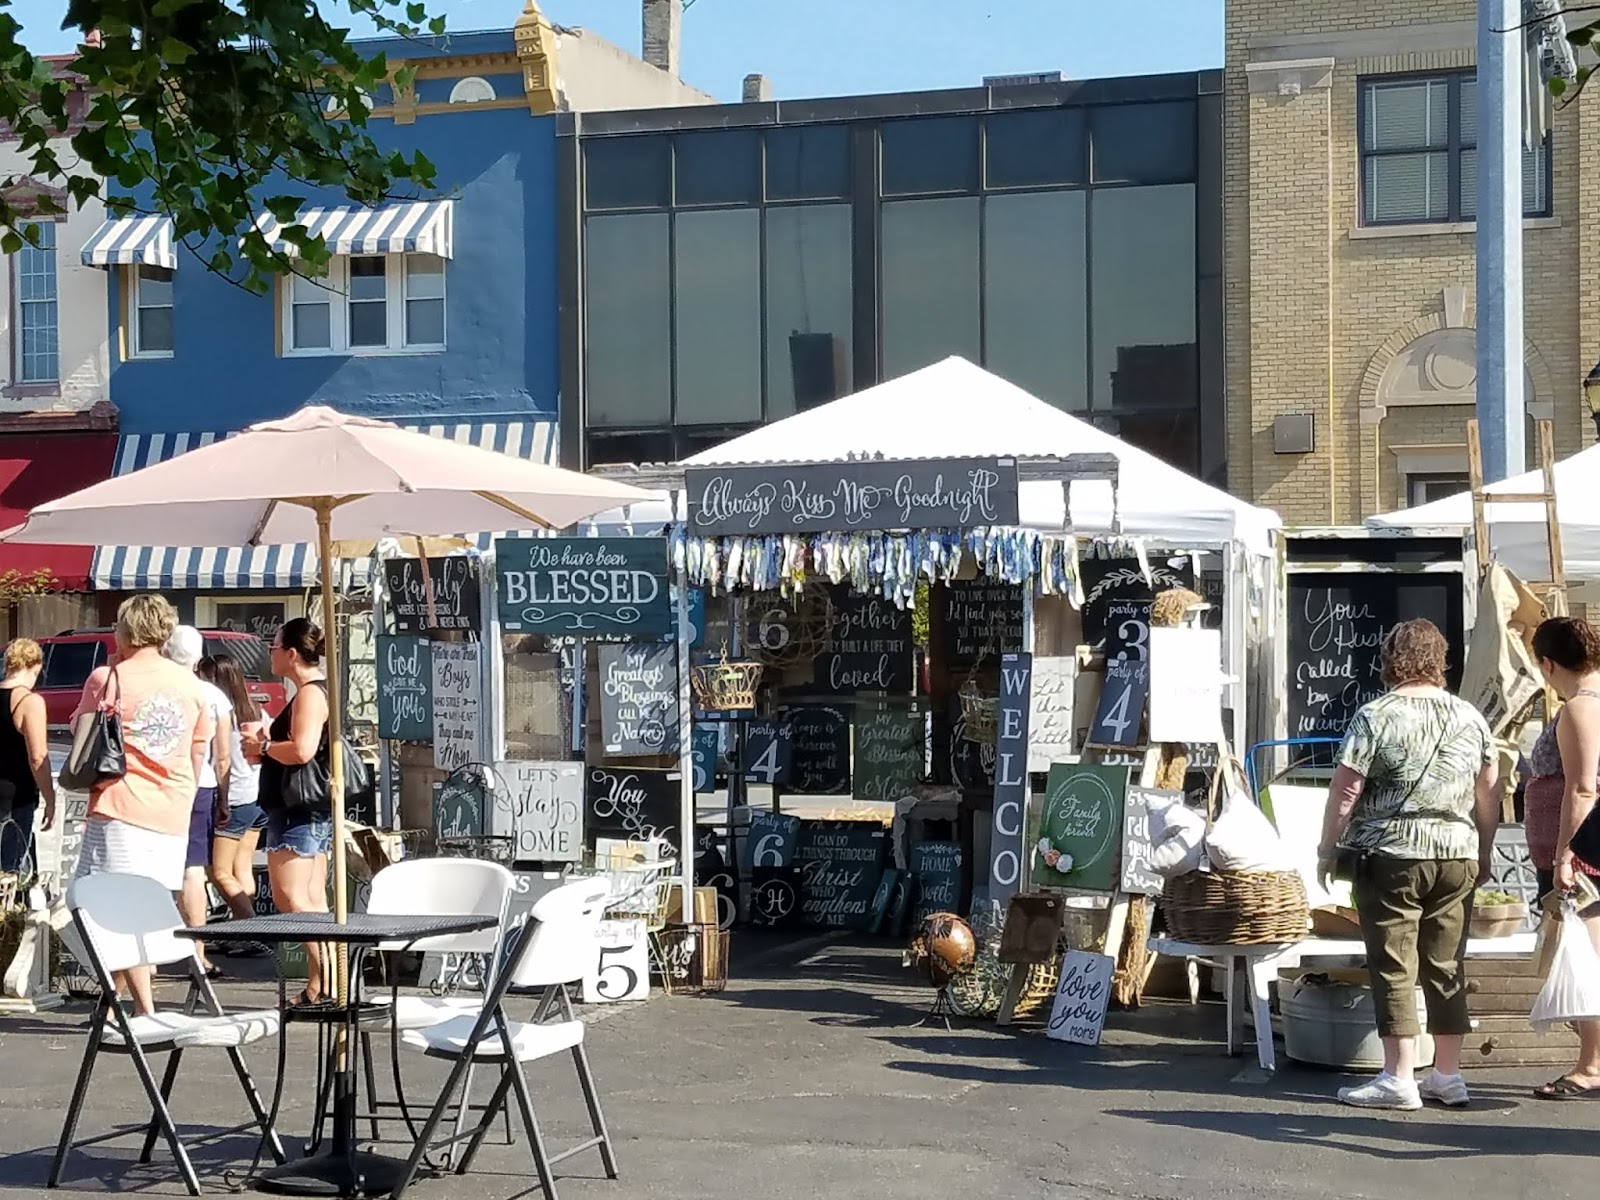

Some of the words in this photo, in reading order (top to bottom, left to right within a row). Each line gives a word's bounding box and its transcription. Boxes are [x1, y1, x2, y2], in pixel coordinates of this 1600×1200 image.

[696, 477, 776, 527] Always
[781, 479, 835, 524] Kiss
[834, 479, 892, 524] Me
[894, 468, 999, 523] Goodnight
[530, 545, 559, 568] We
[561, 545, 594, 567] have
[595, 545, 627, 566] been
[504, 570, 659, 604] BLESSED
[954, 590, 966, 602] TO
[964, 603, 985, 625] find
[1108, 603, 1138, 618] party
[1305, 588, 1375, 652] Your
[759, 609, 789, 650] 6
[1118, 620, 1148, 661] 3
[1334, 622, 1390, 655] Husb
[388, 643, 422, 677] God
[626, 654, 646, 669] MY
[830, 653, 896, 690] loved
[393, 678, 406, 687] GAVE
[408, 678, 416, 687] ME
[438, 662, 471, 693] Boys
[1105, 662, 1132, 685] party
[1134, 664, 1146, 684] of
[392, 693, 425, 734] you
[446, 697, 460, 707] STOLE
[1102, 684, 1132, 742] 4
[749, 723, 776, 740] party
[779, 723, 792, 740] of
[876, 712, 892, 725] MY
[439, 743, 472, 769] Mom
[751, 739, 782, 783] 4
[592, 771, 648, 817] You
[622, 805, 644, 830] &
[752, 814, 779, 832] party
[783, 817, 796, 833] of
[1059, 794, 1101, 831] Family
[754, 834, 784, 867] 6
[818, 834, 835, 846] CAN
[836, 835, 849, 847] DO
[834, 848, 877, 862] THROUGH
[920, 856, 951, 872] HOME
[765, 889, 786, 913] H
[810, 886, 836, 897] WHO
[802, 889, 867, 923] engthens
[826, 914, 845, 925] ME
[595, 944, 638, 1000] 5
[1084, 959, 1097, 973] i
[1061, 966, 1104, 1000] love
[1050, 1002, 1102, 1030] you
